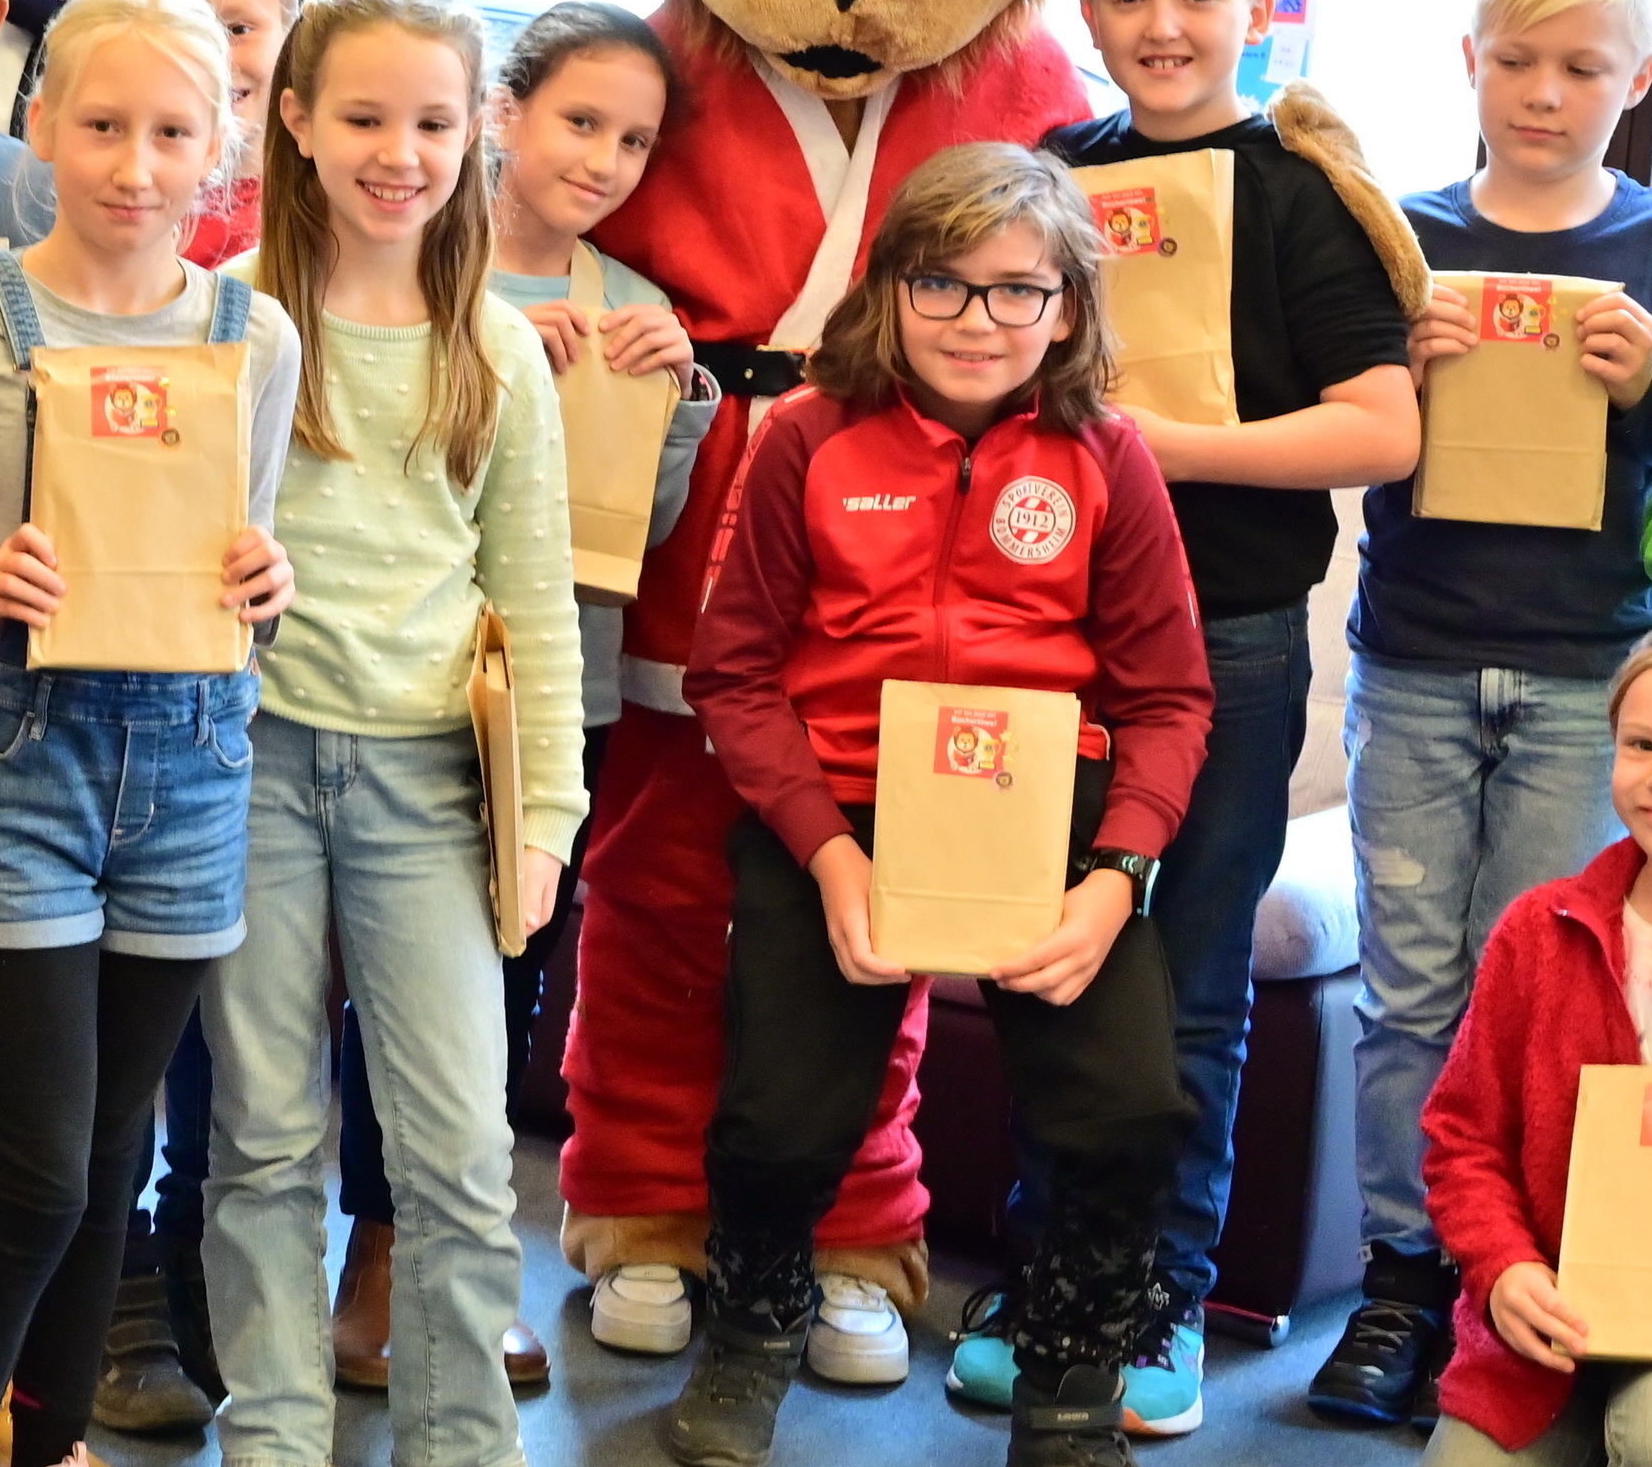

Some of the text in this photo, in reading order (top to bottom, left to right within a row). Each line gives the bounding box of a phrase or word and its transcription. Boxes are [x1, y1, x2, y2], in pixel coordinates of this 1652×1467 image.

[843, 493, 917, 512] saller
[1002, 483, 1071, 519] SPORTVEREIN
[1014, 510, 1049, 528] 1912
[995, 517, 1066, 559] BOMMERSHEIM
